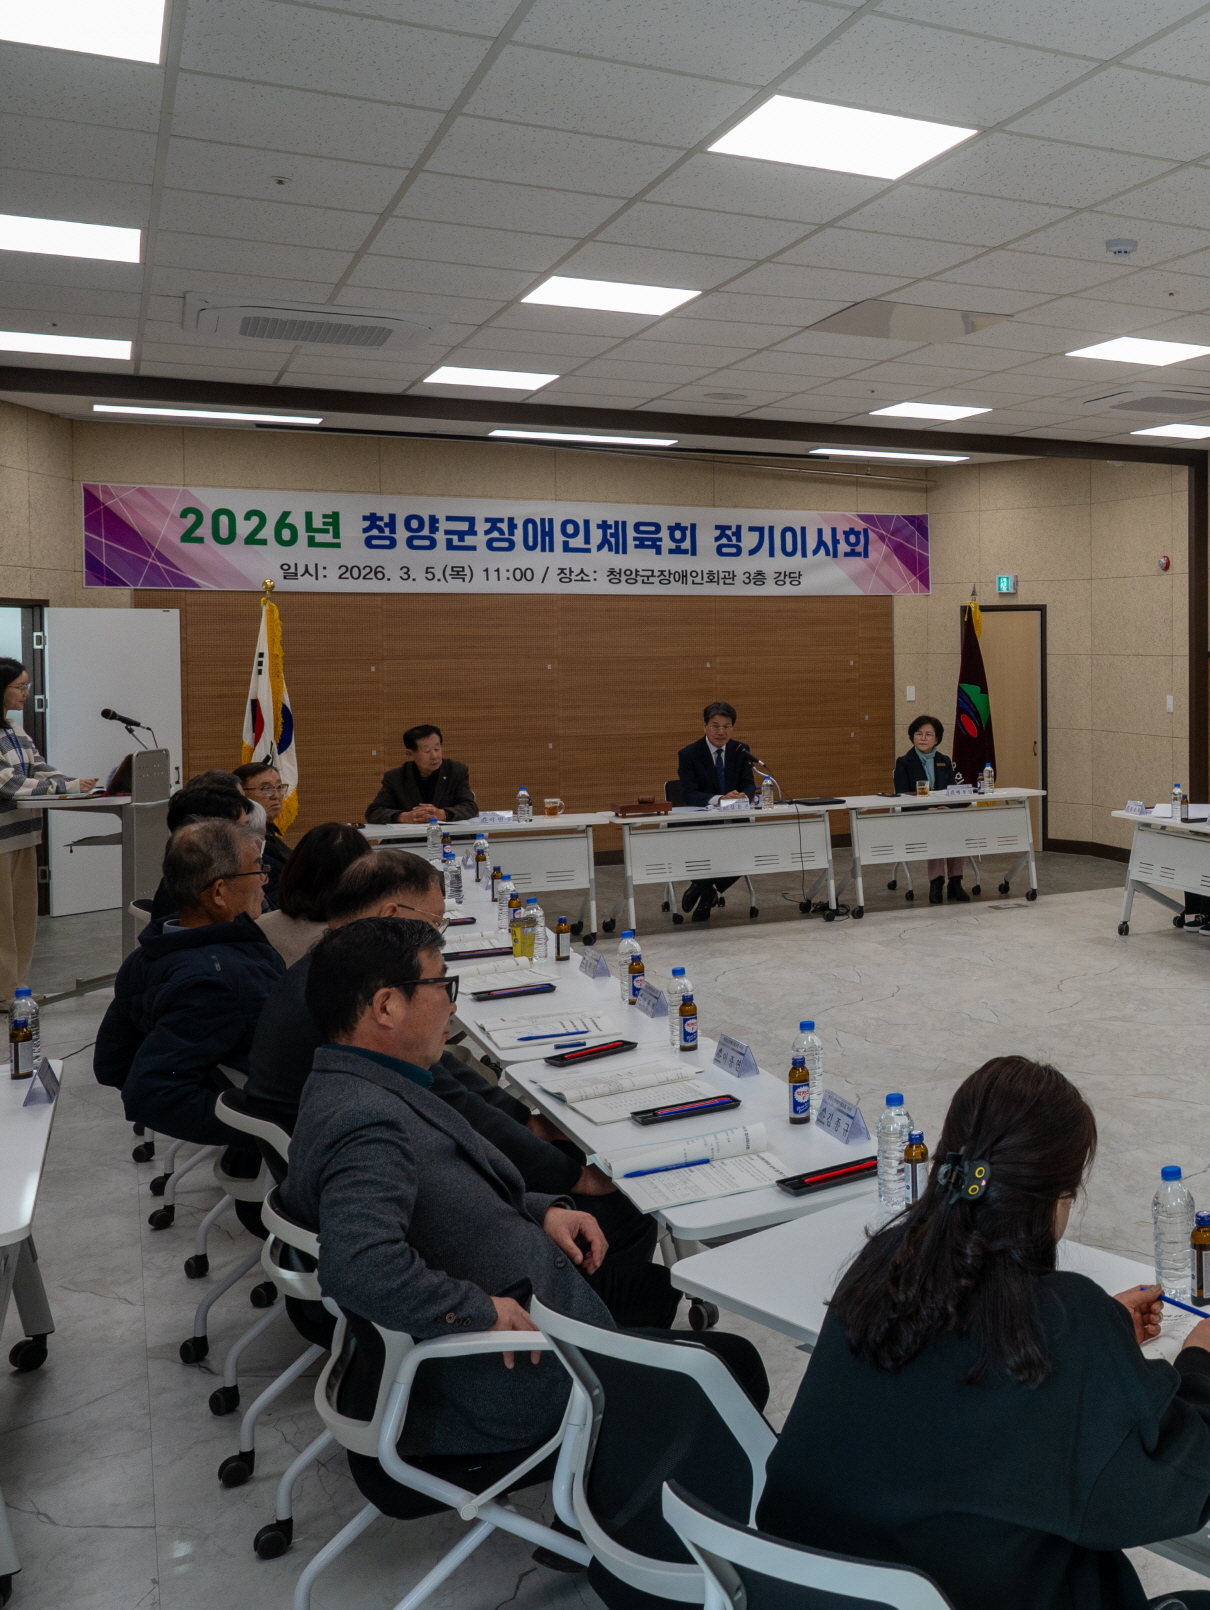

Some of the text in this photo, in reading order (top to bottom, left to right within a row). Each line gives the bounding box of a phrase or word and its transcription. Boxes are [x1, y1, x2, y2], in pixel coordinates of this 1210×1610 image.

[179, 506, 870, 559] 2026년 청양군장애인체육회 정기이사회
[280, 562, 328, 581] 일시:
[337, 564, 392, 582] 2026.
[399, 565, 417, 582] 3.
[424, 564, 474, 583] 5.(목)
[482, 567, 534, 583] 11:00
[556, 567, 598, 584] 장소:
[606, 567, 737, 586] 청양군장애인회관
[742, 570, 768, 586] 3층
[773, 570, 802, 587] 강당
